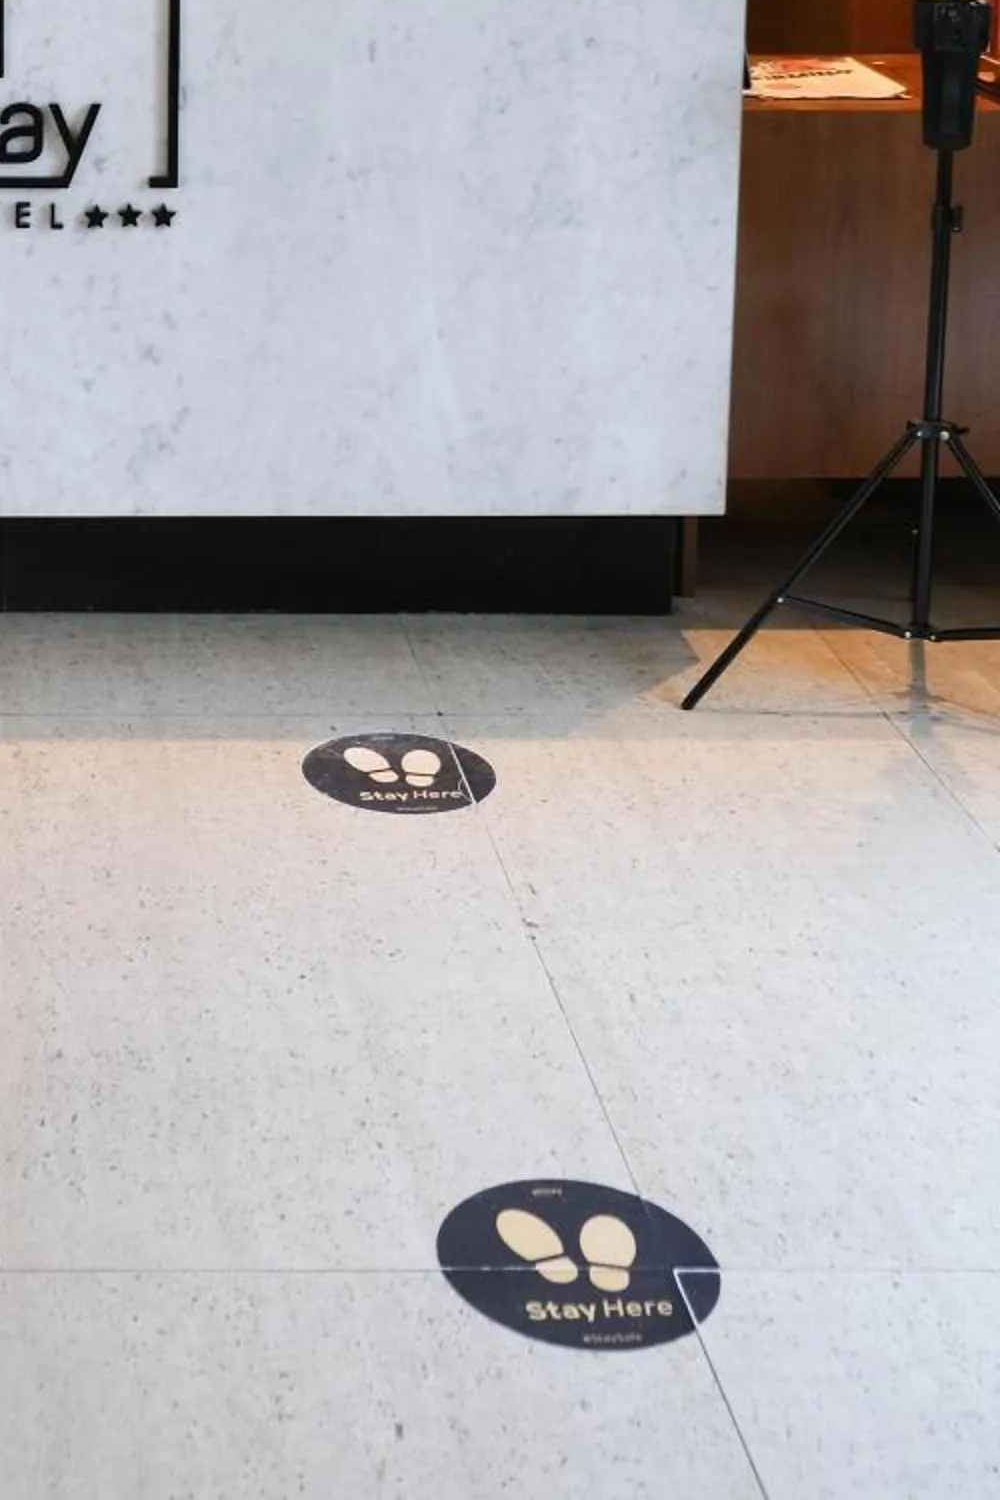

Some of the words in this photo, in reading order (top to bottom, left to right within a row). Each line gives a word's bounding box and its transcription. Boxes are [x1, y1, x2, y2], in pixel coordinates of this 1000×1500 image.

[359, 790, 408, 802] Stay
[413, 790, 462, 800] Here
[525, 1300, 598, 1323] Stay
[602, 1298, 673, 1318] Here
